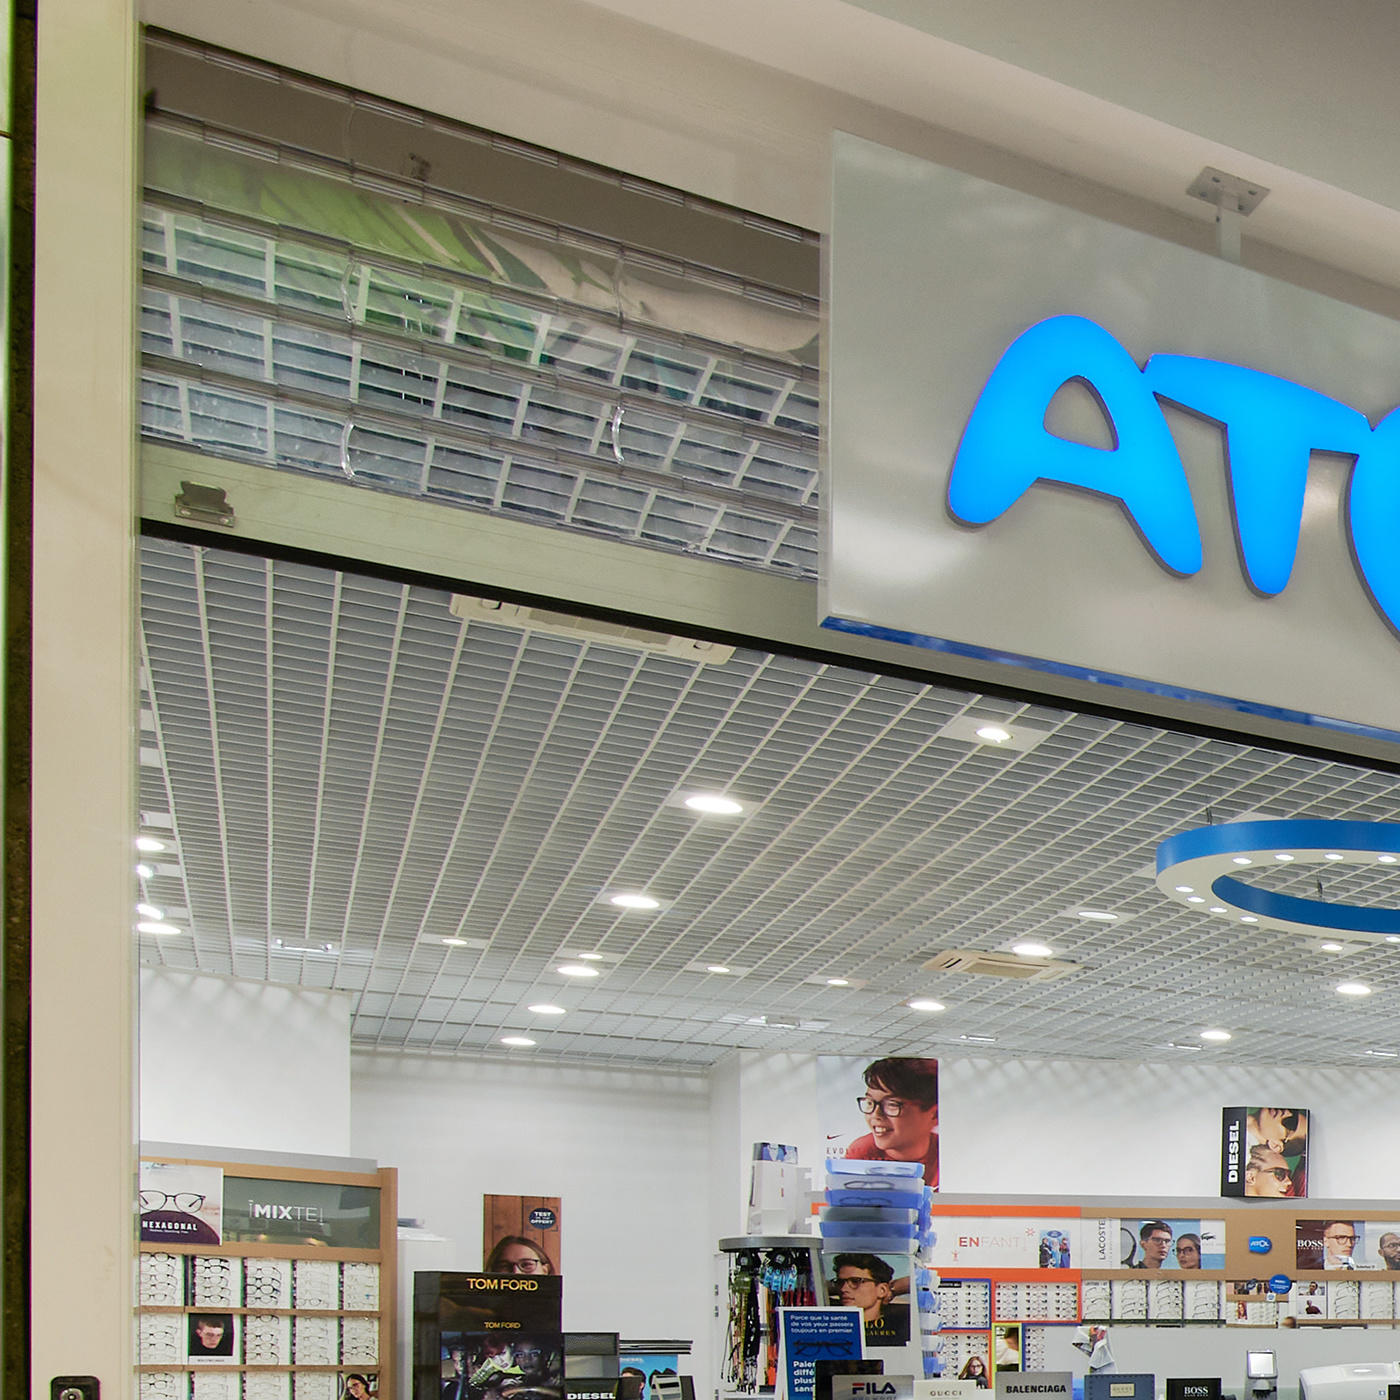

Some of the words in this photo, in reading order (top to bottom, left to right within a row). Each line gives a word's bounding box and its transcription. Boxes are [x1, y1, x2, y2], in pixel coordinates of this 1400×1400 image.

[1228, 1120, 1240, 1183] DIESEL
[253, 1204, 317, 1222] MIXTE
[959, 1236, 1019, 1248] ENFANT
[467, 1278, 498, 1290] TOM
[500, 1279, 538, 1291] FORD
[852, 1382, 896, 1394] FILA
[1006, 1384, 1067, 1393] BALENCIAGA
[1184, 1386, 1208, 1395] BOSS
[567, 1392, 616, 1400] DIESEL
